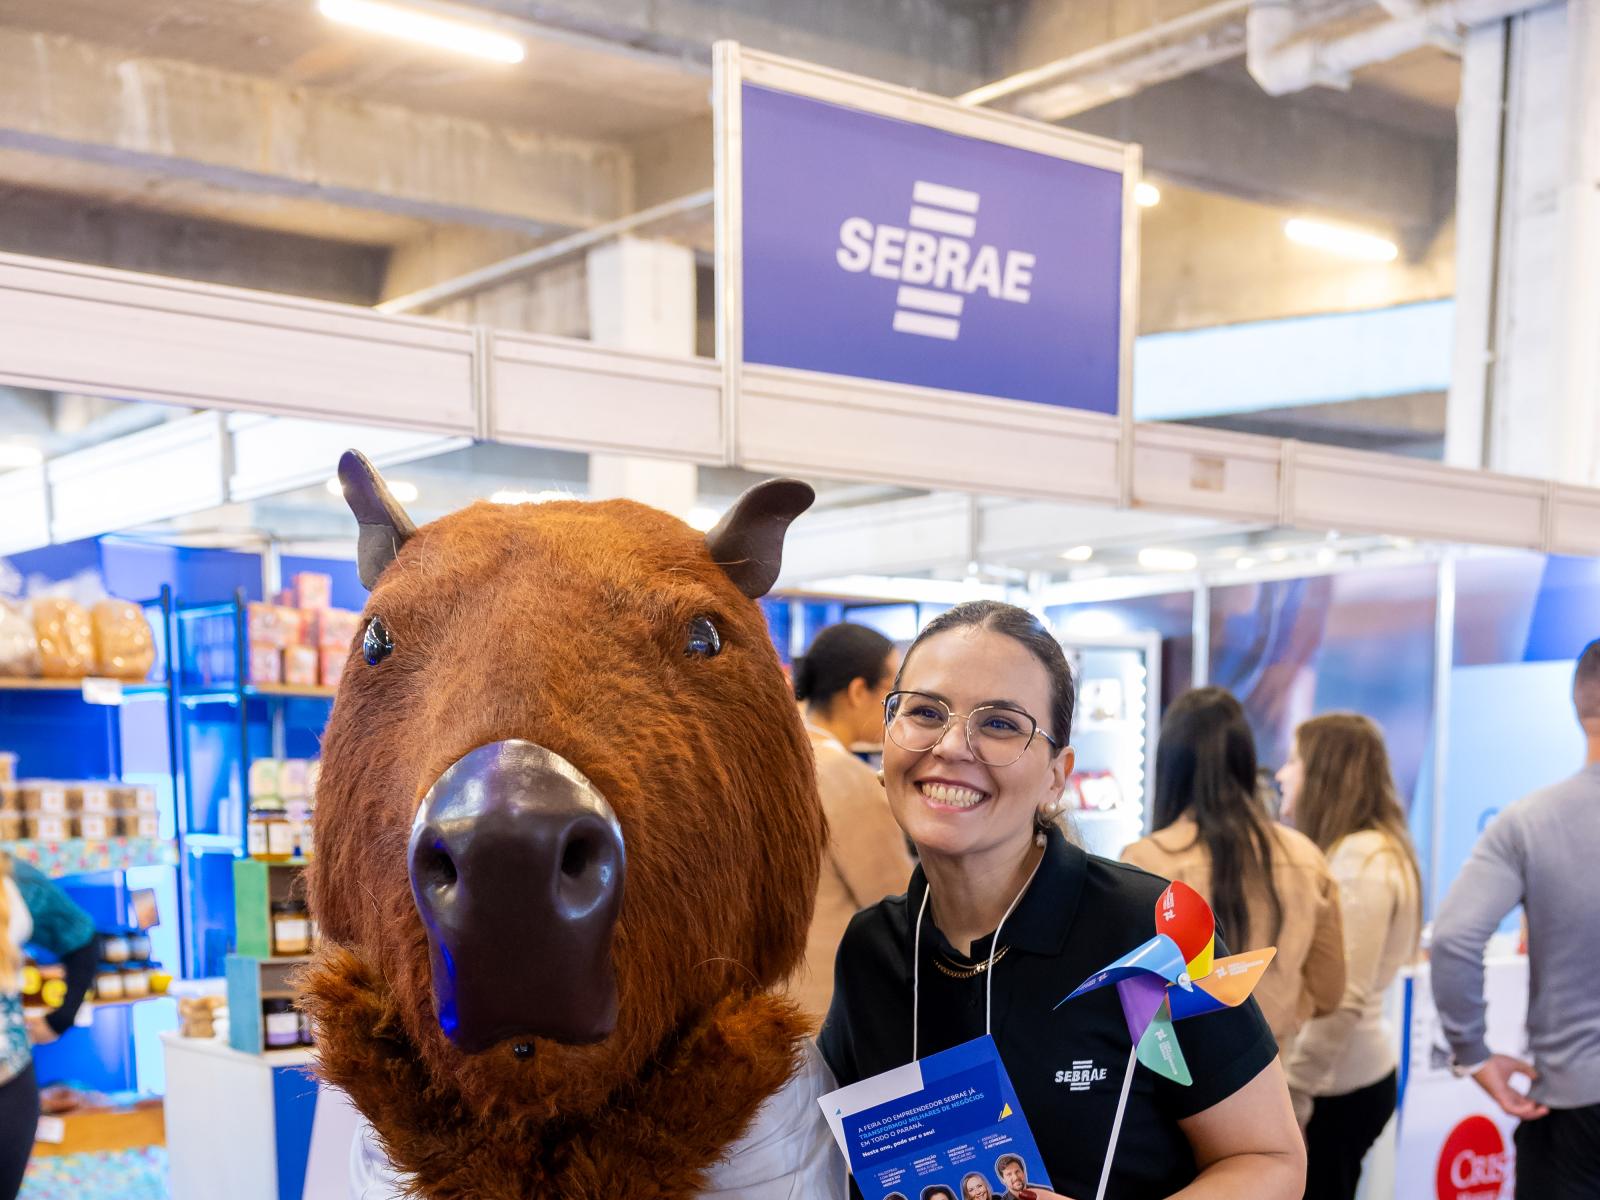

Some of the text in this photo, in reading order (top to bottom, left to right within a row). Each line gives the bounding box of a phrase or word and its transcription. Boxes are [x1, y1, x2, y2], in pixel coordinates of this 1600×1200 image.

[836, 217, 1036, 304] SEBRAE
[1055, 1068, 1107, 1083] SEBRAE
[859, 1119, 907, 1139] TRANSFORMOU
[908, 1108, 941, 1123] MILHARES
[941, 1104, 950, 1112] DE
[863, 1121, 881, 1130] FEIRA
[882, 1116, 892, 1124] DO
[892, 1100, 943, 1120] EMPREENDEDOR
[943, 1090, 967, 1103] SEBRAE
[871, 1133, 889, 1142] TODO
